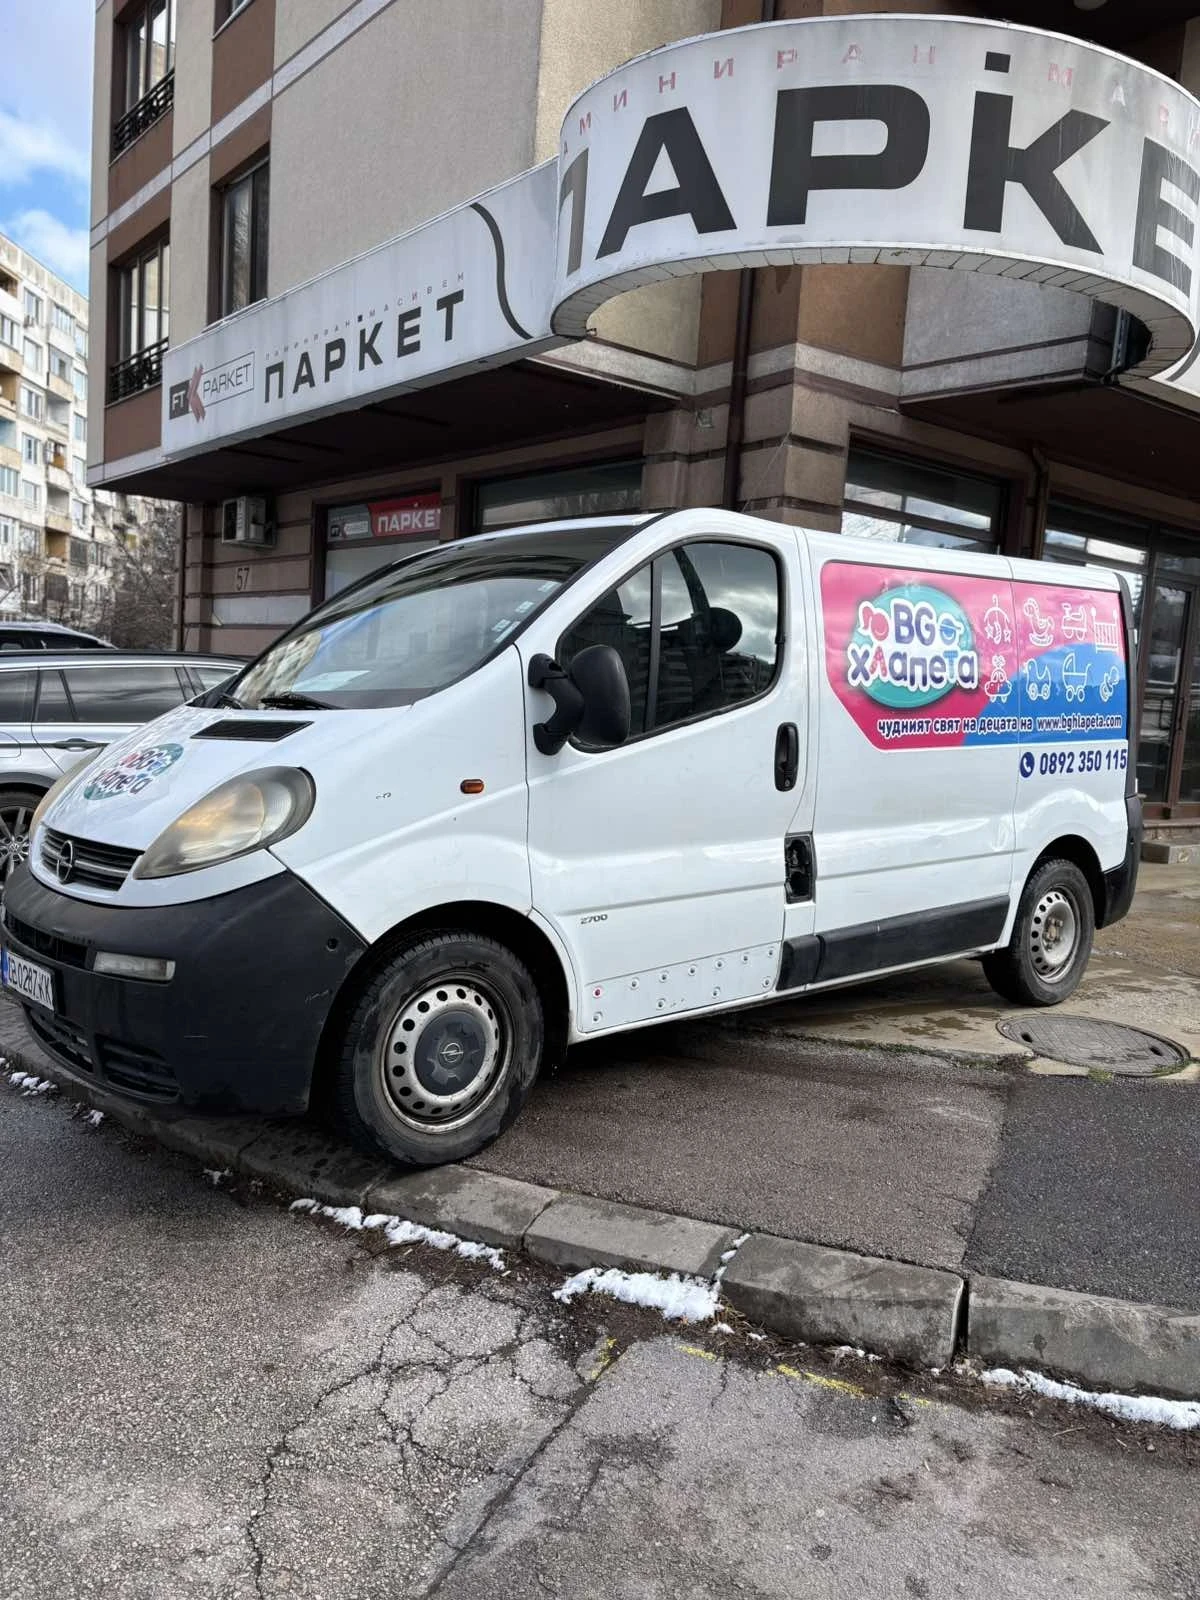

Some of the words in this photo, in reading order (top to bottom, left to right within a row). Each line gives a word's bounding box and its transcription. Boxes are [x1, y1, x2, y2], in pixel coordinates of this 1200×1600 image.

[369, 271, 465, 317] МАСИВЕН
[264, 288, 465, 404] ПАРКЕТ
[203, 363, 252, 400] PARKET
[236, 567, 250, 591] 57
[893, 602, 936, 646] BG
[878, 718, 932, 738] чудният
[933, 718, 961, 733] свят
[963, 717, 978, 732] на
[979, 715, 1018, 734] децата
[1020, 716, 1033, 731] на
[1037, 713, 1121, 733] www.bghlapeta.com
[1039, 751, 1075, 775] 0892
[1078, 750, 1102, 773] 350
[1105, 748, 1127, 770] 115
[580, 913, 608, 925] 2700
